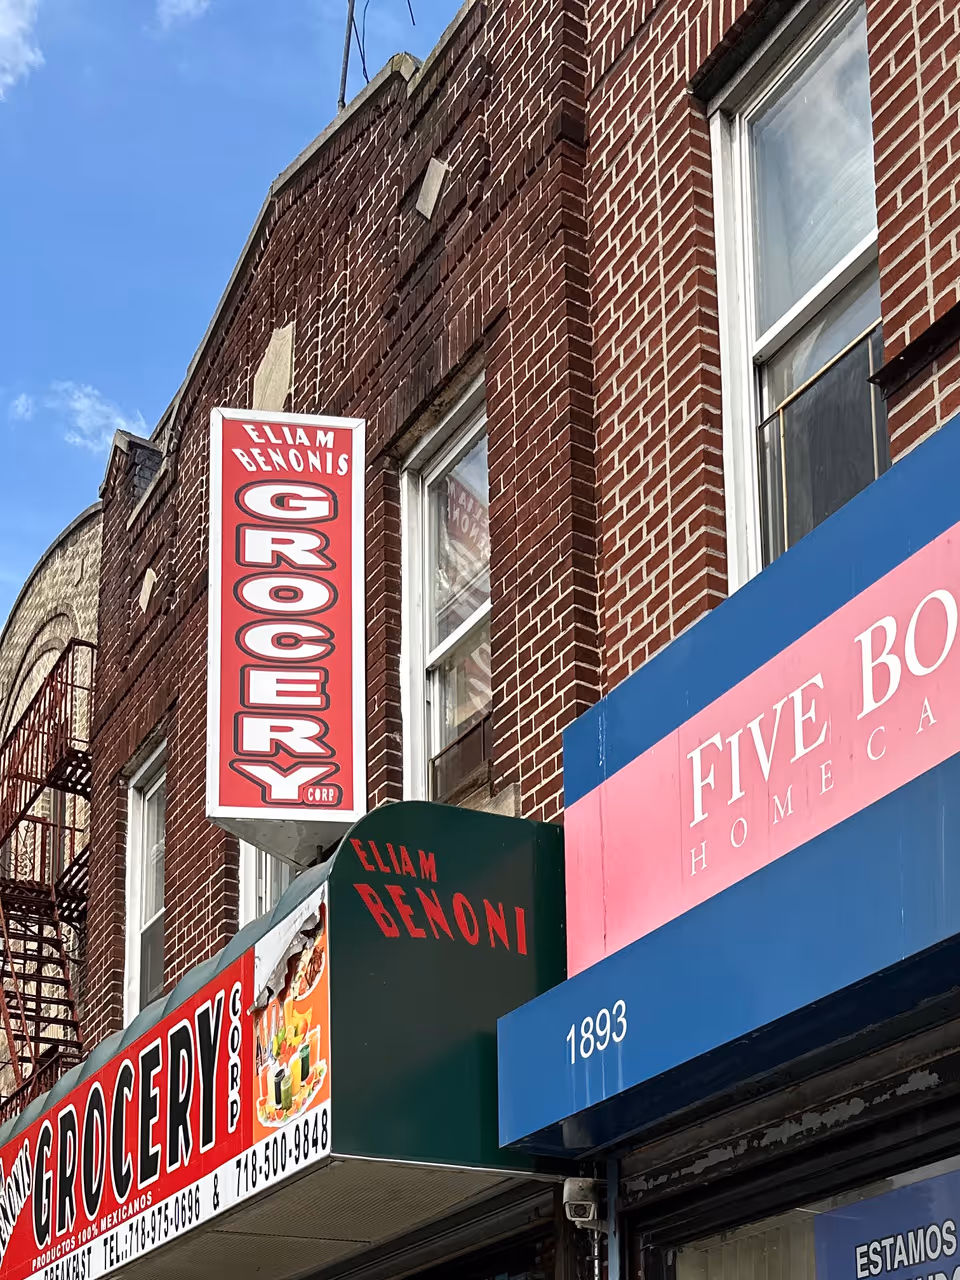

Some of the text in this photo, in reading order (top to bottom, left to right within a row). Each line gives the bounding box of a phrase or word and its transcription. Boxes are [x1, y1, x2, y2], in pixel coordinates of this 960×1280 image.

[231, 447, 350, 476] BENONIS
[241, 423, 335, 449] ELIAM
[234, 480, 340, 805] GROCERY
[685, 673, 831, 828] FIVE
[307, 788, 335, 802] CORP
[349, 838, 439, 882] ELIAM
[353, 883, 529, 957] BENONI
[228, 981, 242, 1134] CORP
[565, 999, 628, 1066] 1893
[32, 988, 225, 1251] GROCERY
[212, 1172, 220, 1210] &
[235, 1107, 329, 1198] 718-500-9848
[32, 1190, 153, 1271] PRODUCTOS 100% MEXICANOS
[856, 1219, 958, 1279] ESTAMOS
